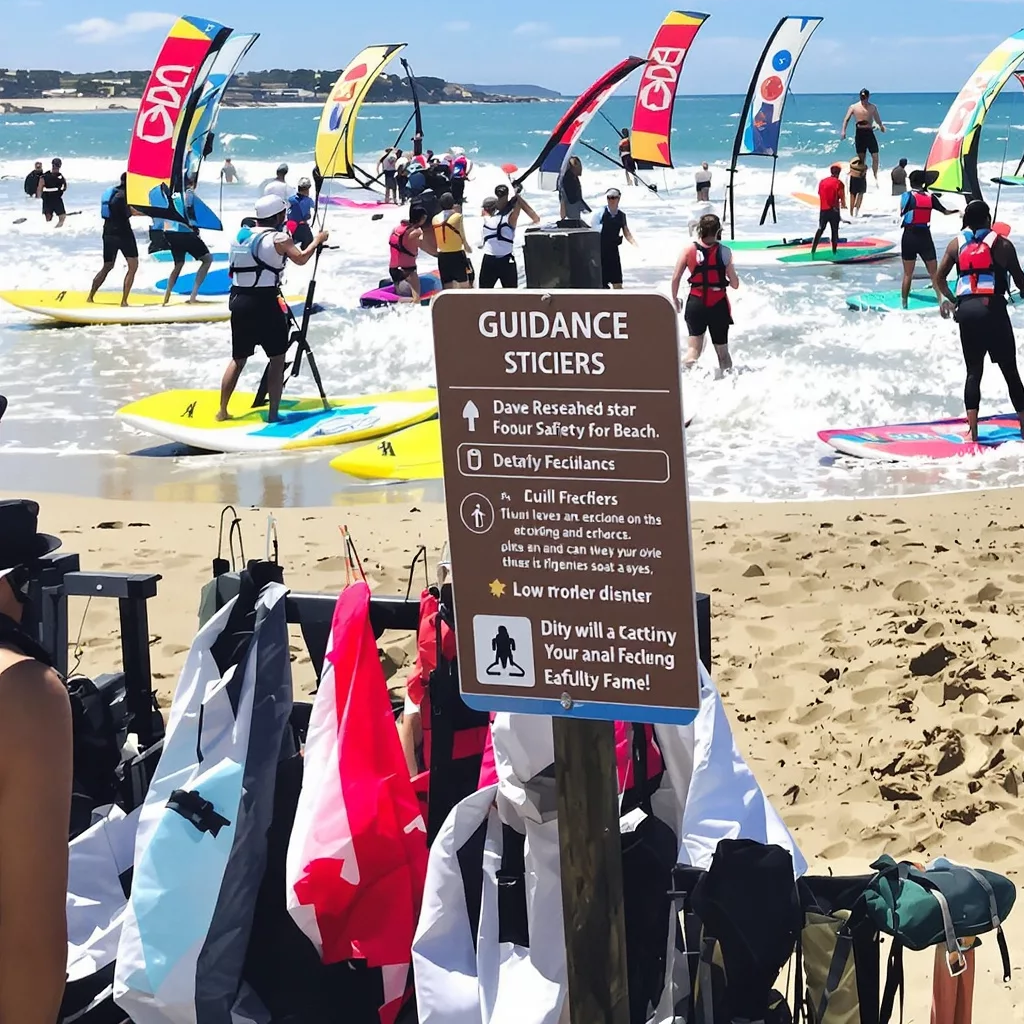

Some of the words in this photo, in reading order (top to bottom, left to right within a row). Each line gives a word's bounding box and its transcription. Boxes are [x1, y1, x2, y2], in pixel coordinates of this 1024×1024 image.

[479, 311, 628, 339] GUIDANCE
[504, 351, 605, 375] STICIERS
[493, 400, 529, 415] Dave
[589, 423, 610, 438] for
[614, 424, 659, 439] Beach.
[628, 514, 641, 525] on
[563, 528, 583, 539] and
[513, 582, 543, 598] Low
[575, 621, 603, 639] will
[545, 644, 577, 660] Your
[604, 673, 651, 690] Fame!
